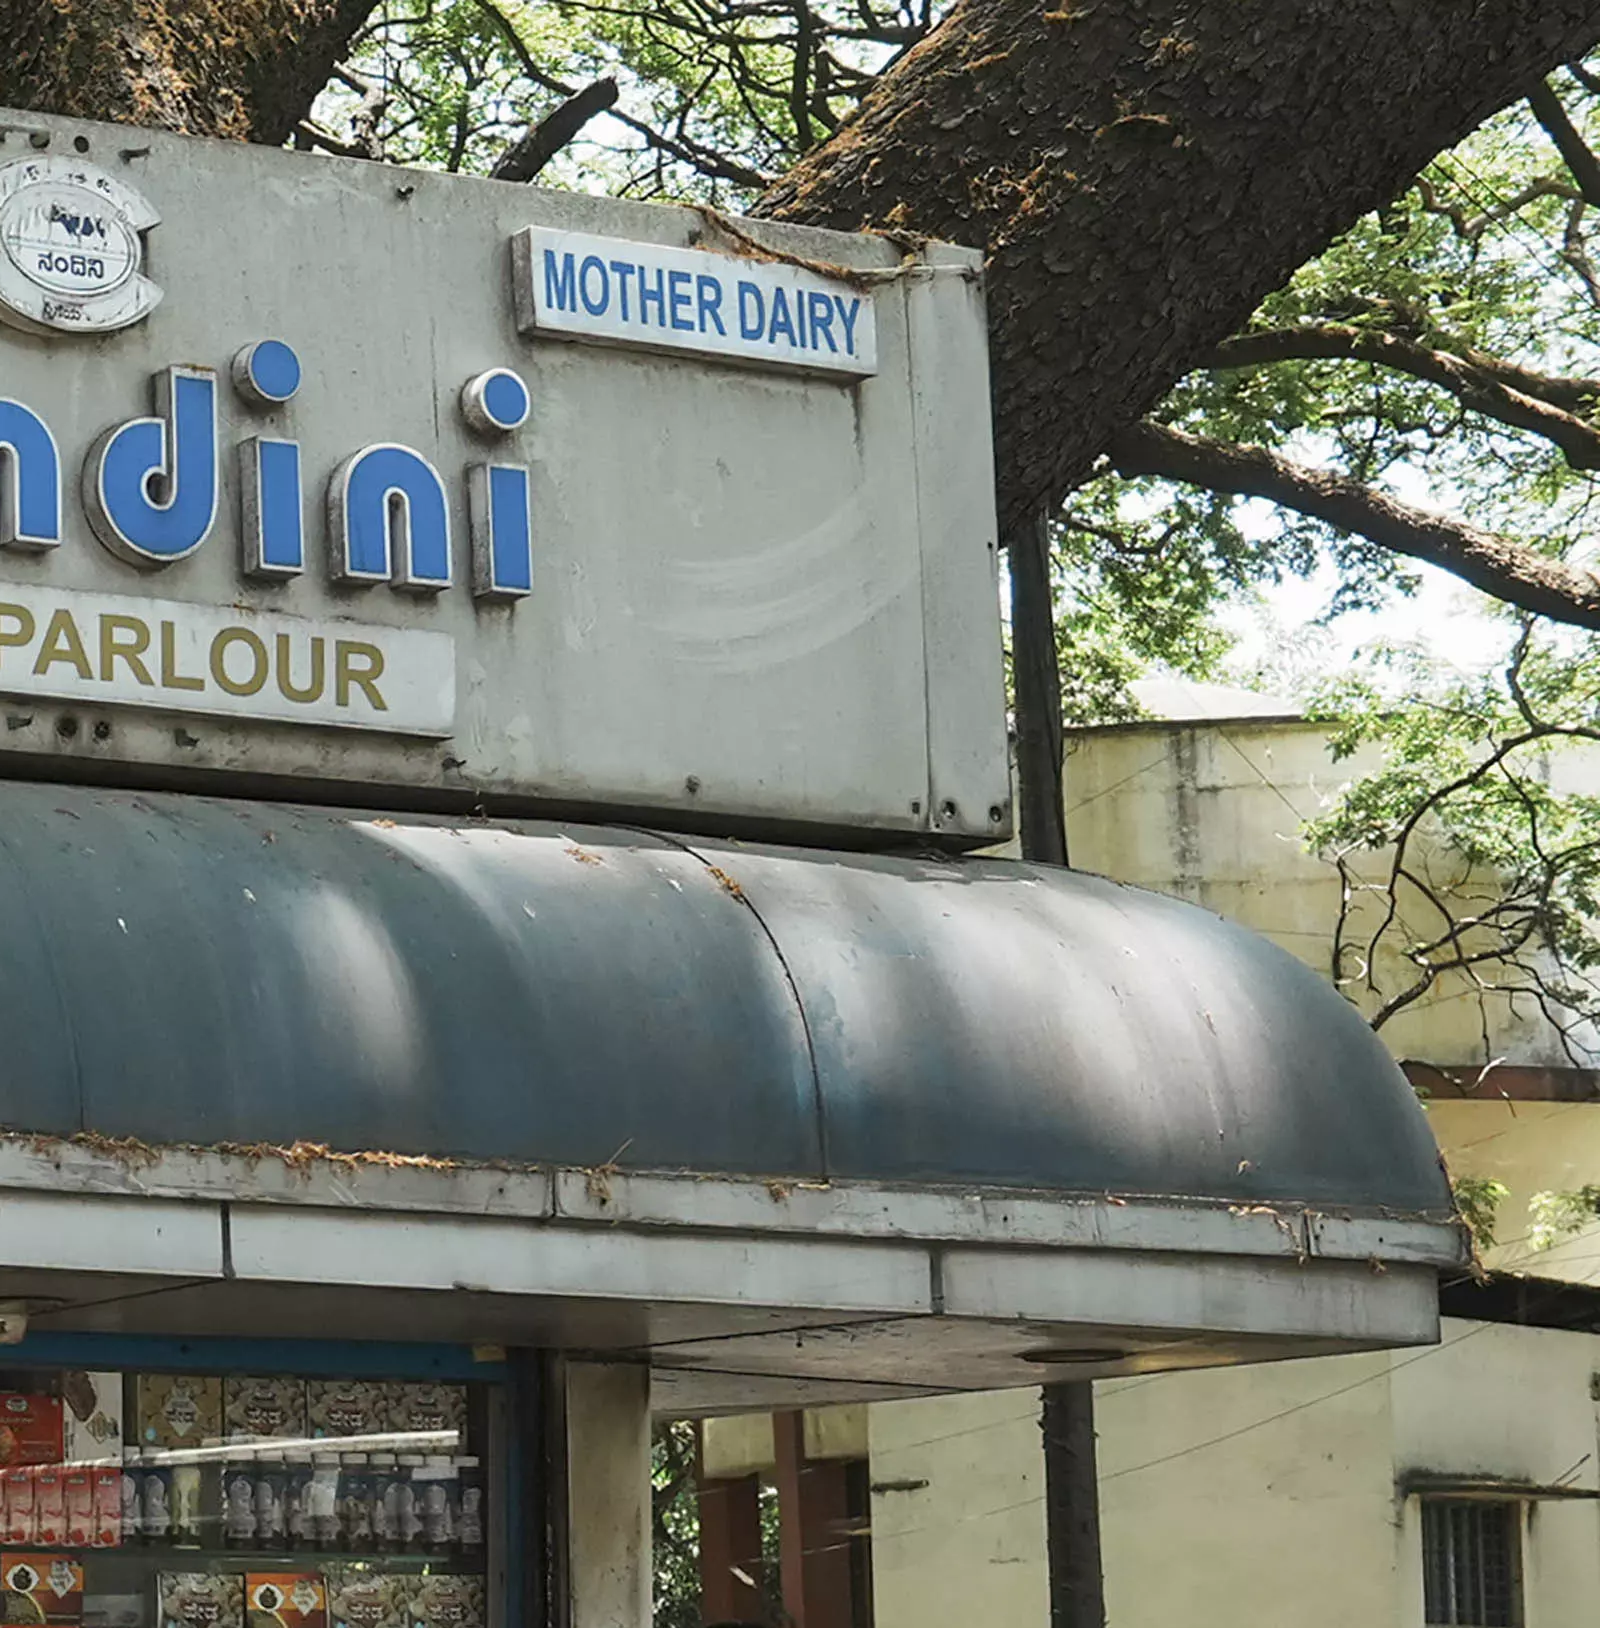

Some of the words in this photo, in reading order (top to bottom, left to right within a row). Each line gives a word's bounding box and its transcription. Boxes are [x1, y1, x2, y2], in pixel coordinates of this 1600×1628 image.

[38, 252, 105, 278] ನಂದಿನಿ
[544, 249, 726, 336] MOTHER
[737, 281, 861, 356] DAIRY
